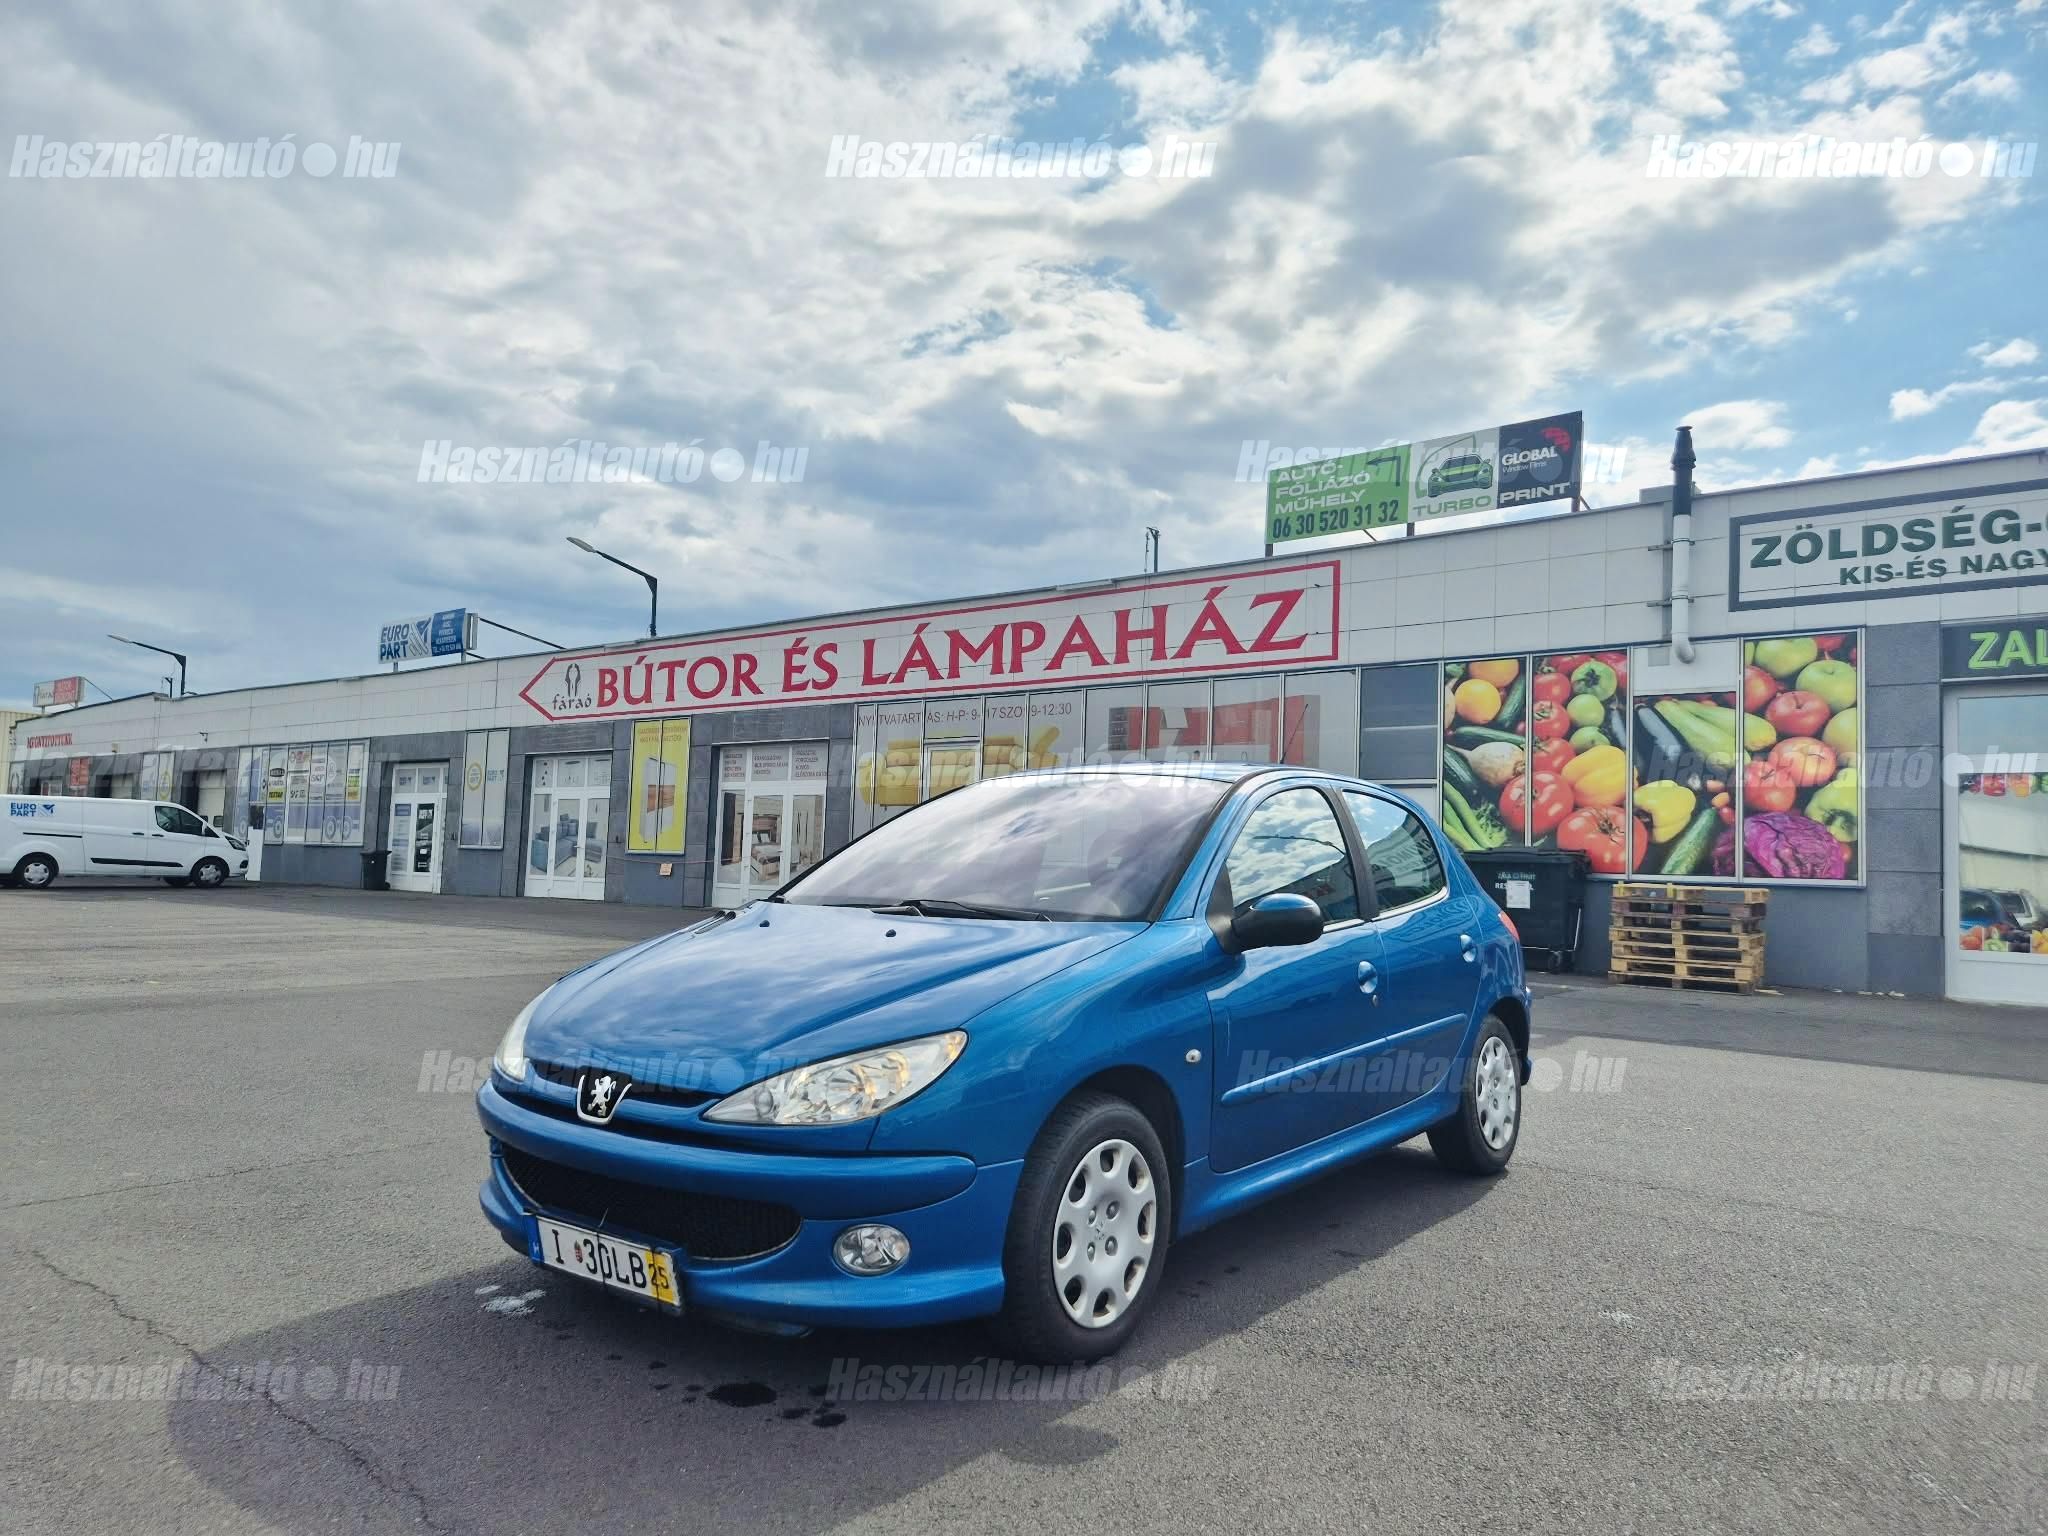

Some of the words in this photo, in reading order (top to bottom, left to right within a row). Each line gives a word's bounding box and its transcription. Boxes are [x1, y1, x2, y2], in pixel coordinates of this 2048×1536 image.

[1502, 445, 1558, 466] GLOBAL
[1501, 482, 1570, 504] PRINT
[1413, 495, 1492, 517] TURBO
[1272, 517, 1291, 539] 06
[1296, 513, 1315, 535] 30
[1319, 508, 1349, 532] 520
[1354, 504, 1372, 527] 31
[1378, 499, 1399, 522] 32
[1750, 505, 2048, 569] ZÖLDSÉG-
[1840, 556, 1948, 586] KIS-ÉS
[381, 623, 410, 642] EURO
[380, 640, 408, 661] PART
[552, 693, 592, 711] fáraó
[596, 655, 764, 708] BÚTOR
[782, 637, 839, 694] ÉS
[861, 585, 1308, 686] LÁMPAHÁZ
[10, 802, 37, 810] EURO
[10, 809, 37, 817] PART
[648, 1263, 669, 1290] 25
